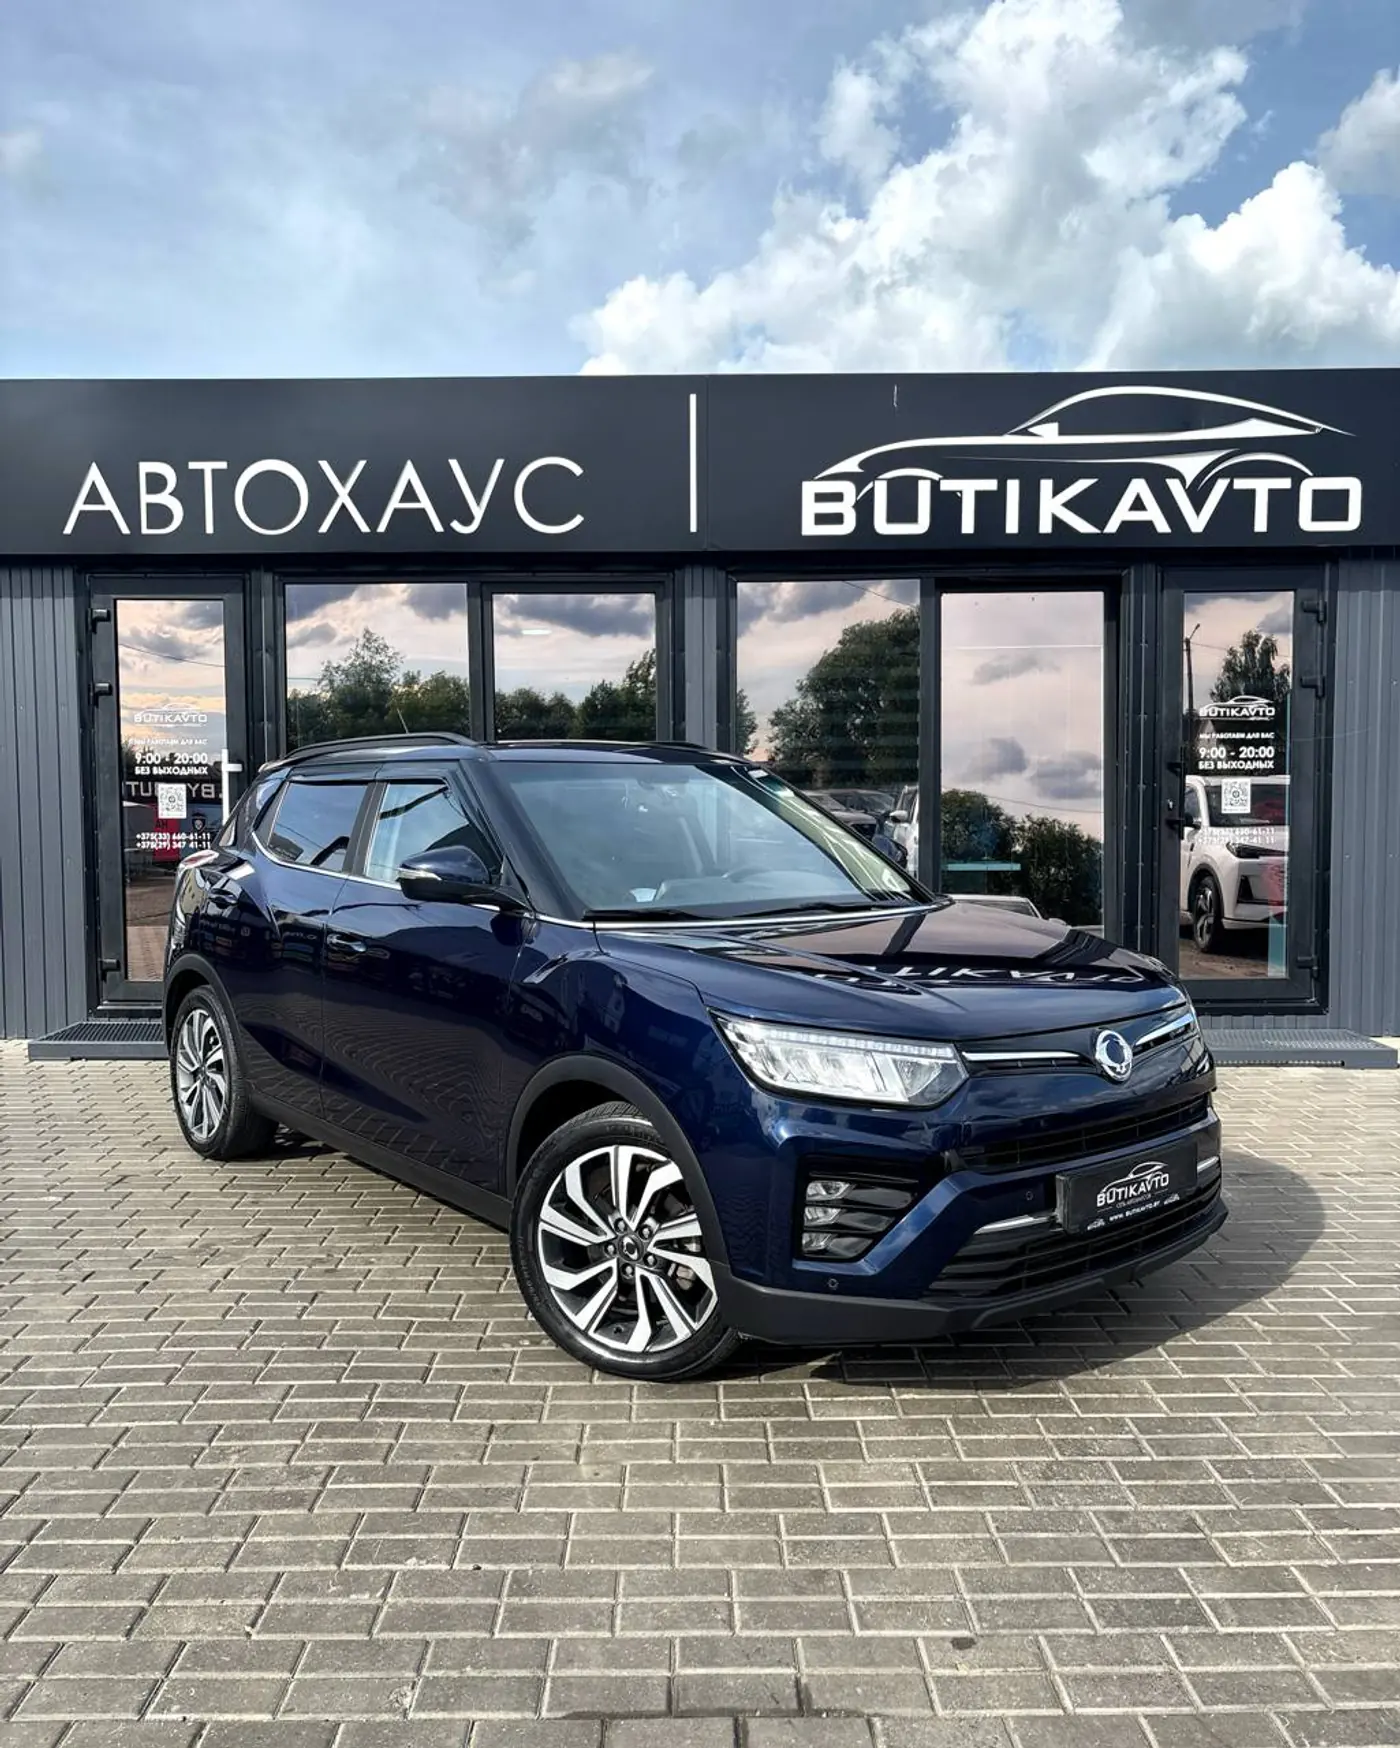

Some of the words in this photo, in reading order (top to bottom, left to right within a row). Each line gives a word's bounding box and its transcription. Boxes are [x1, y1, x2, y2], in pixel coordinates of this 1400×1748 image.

[63, 456, 585, 536] АВТОХАУС
[801, 476, 1363, 537] BUTIKAVTO
[134, 713, 208, 723] BUTIKAVTO
[1199, 707, 1276, 717] BUTIKAVTO
[135, 752, 161, 764] 9:00
[174, 752, 208, 764] 20:00
[1199, 746, 1226, 759] 9:00
[1239, 746, 1275, 759] 20:00
[134, 766, 150, 775] БЕЗ
[152, 766, 208, 776] ВЫХОДНЫХ
[1198, 761, 1215, 770] БЕЗ
[1216, 760, 1275, 770] ВЫХОДНЫХ
[1096, 1173, 1170, 1207] BUTIKAVTO
